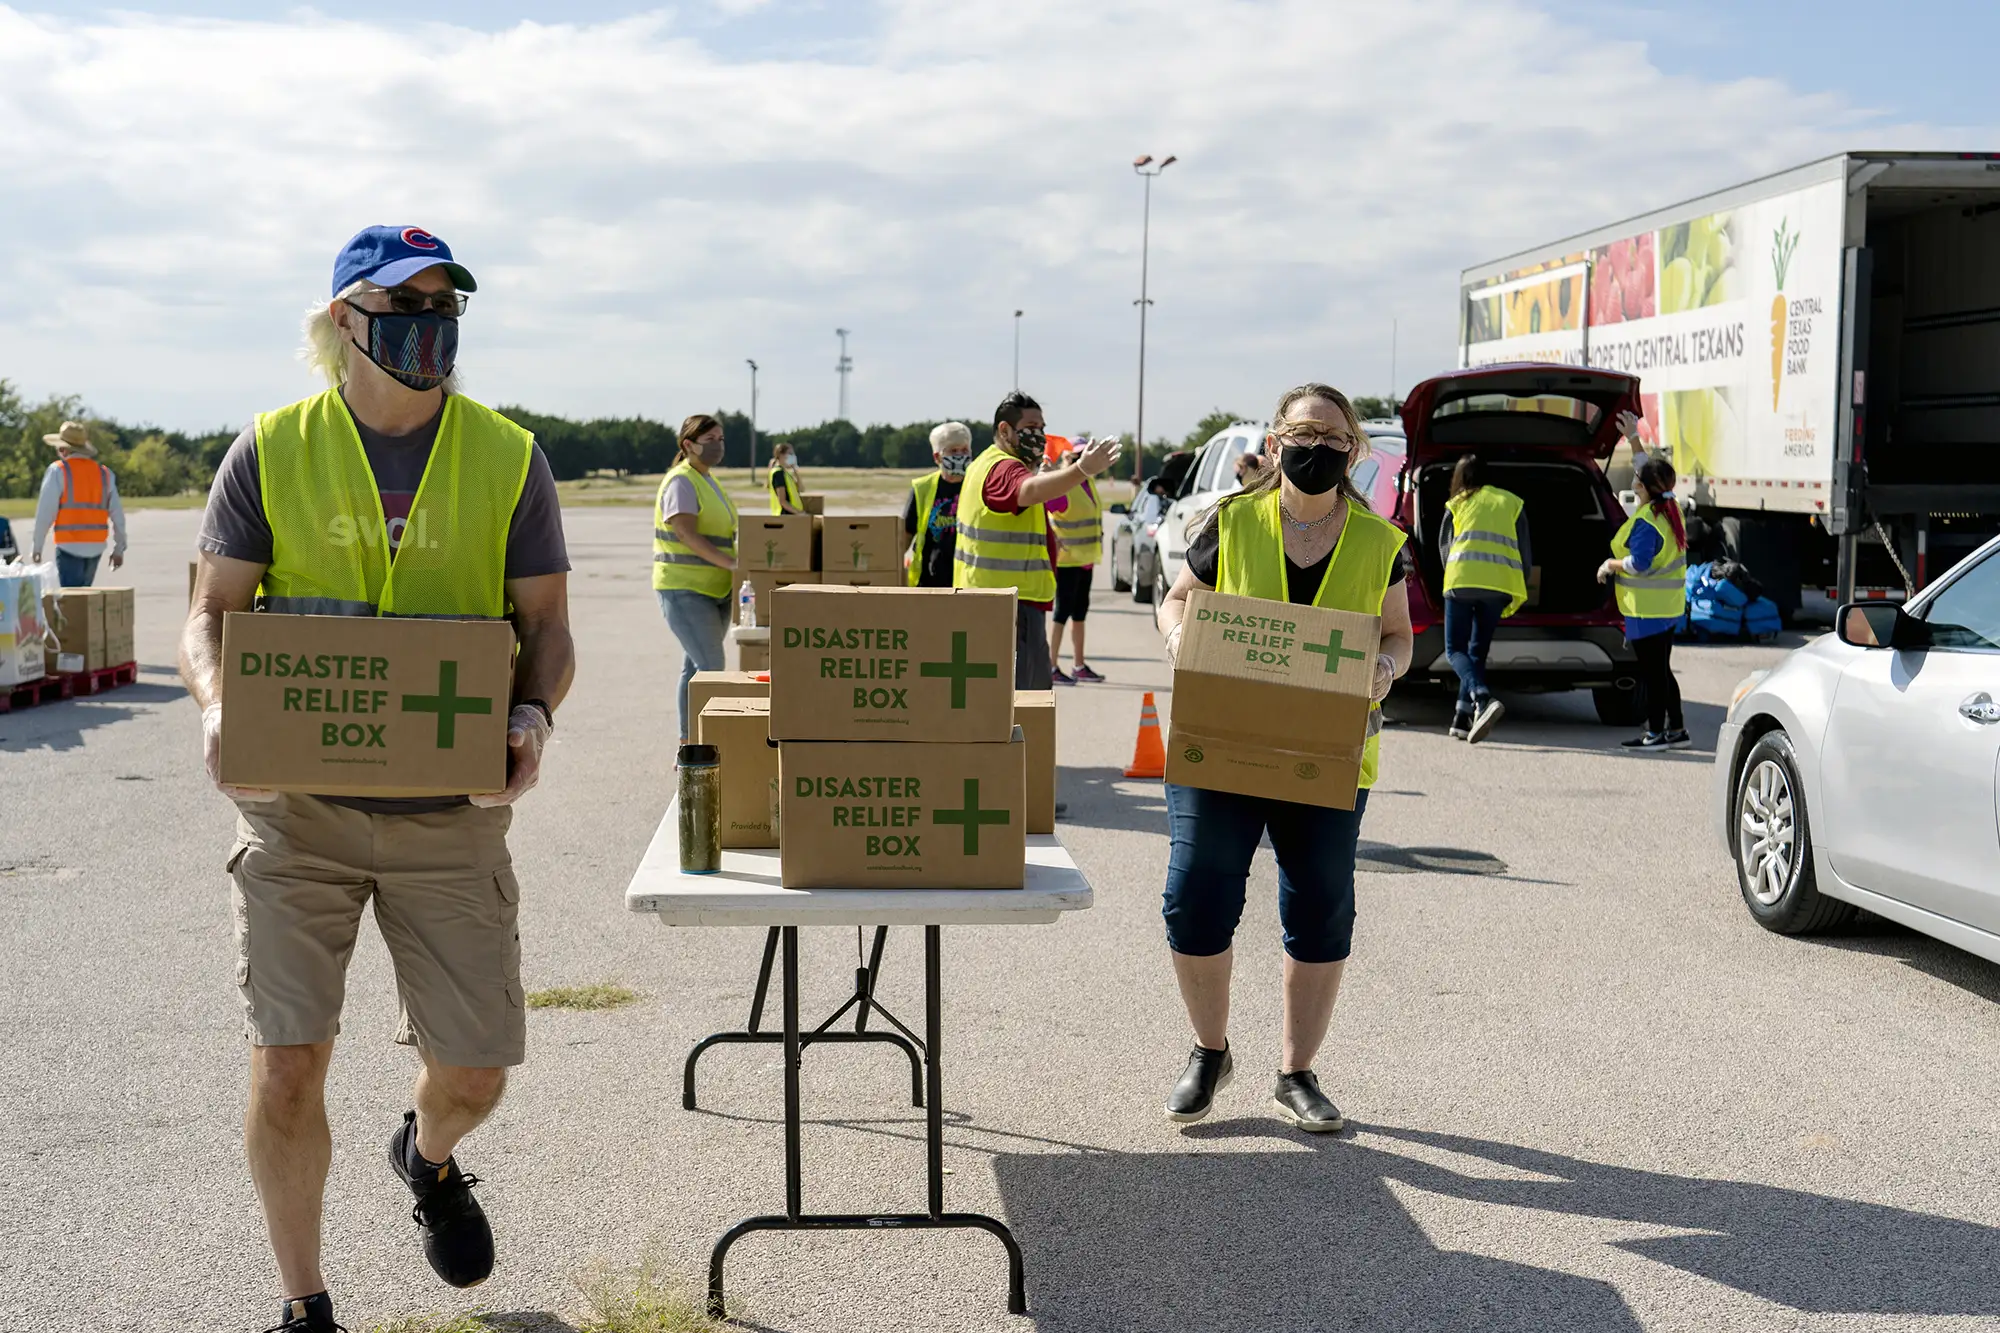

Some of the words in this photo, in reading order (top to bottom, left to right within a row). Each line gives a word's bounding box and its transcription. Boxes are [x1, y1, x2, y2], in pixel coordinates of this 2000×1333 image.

[401, 227, 439, 250] C
[1789, 297, 1822, 317] CENTRAL
[1789, 318, 1812, 336] TEXAS
[1618, 341, 1632, 370] TO
[1635, 335, 1689, 370] CENTRAL
[1692, 322, 1744, 362] TEXANS
[1787, 338, 1809, 356] FOOD
[1787, 358, 1807, 375] BANK
[1196, 608, 1297, 634] DISASTER
[783, 627, 908, 650] DISASTER
[1222, 628, 1295, 650] RELIEF
[241, 652, 389, 680] DISASTER
[1245, 648, 1291, 667] BOX
[820, 658, 908, 679] RELIEF
[283, 687, 388, 713] RELIEF
[853, 687, 908, 709] BOX
[321, 723, 386, 748] BOX
[796, 777, 921, 798] DISASTER
[833, 806, 921, 827] RELIEF
[866, 835, 921, 856] BOX
